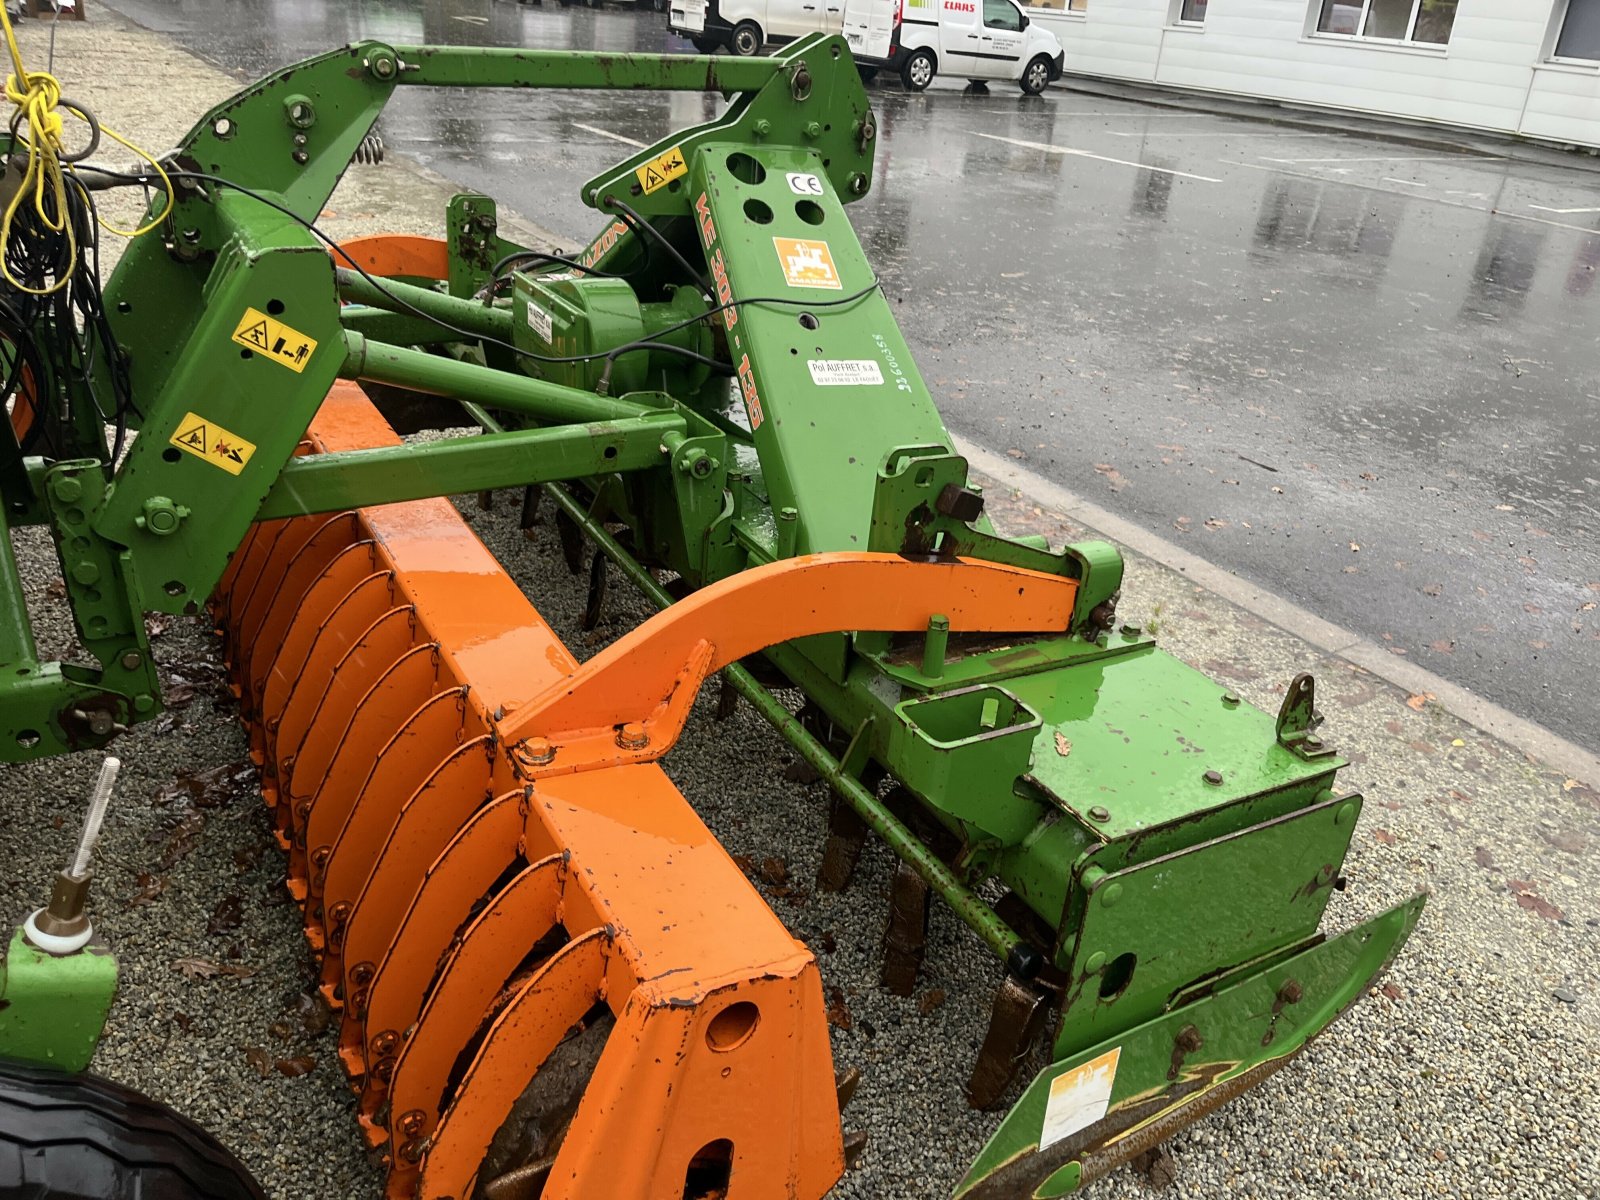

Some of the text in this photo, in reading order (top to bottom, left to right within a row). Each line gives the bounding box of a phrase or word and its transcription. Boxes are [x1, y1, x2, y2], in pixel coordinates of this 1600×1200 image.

[944, 1, 976, 12] CLAAS
[791, 176, 821, 193] CE
[695, 191, 717, 250] KE
[710, 248, 738, 331] 303
[738, 353, 764, 430] 135
[826, 362, 861, 373] AUFFRET
